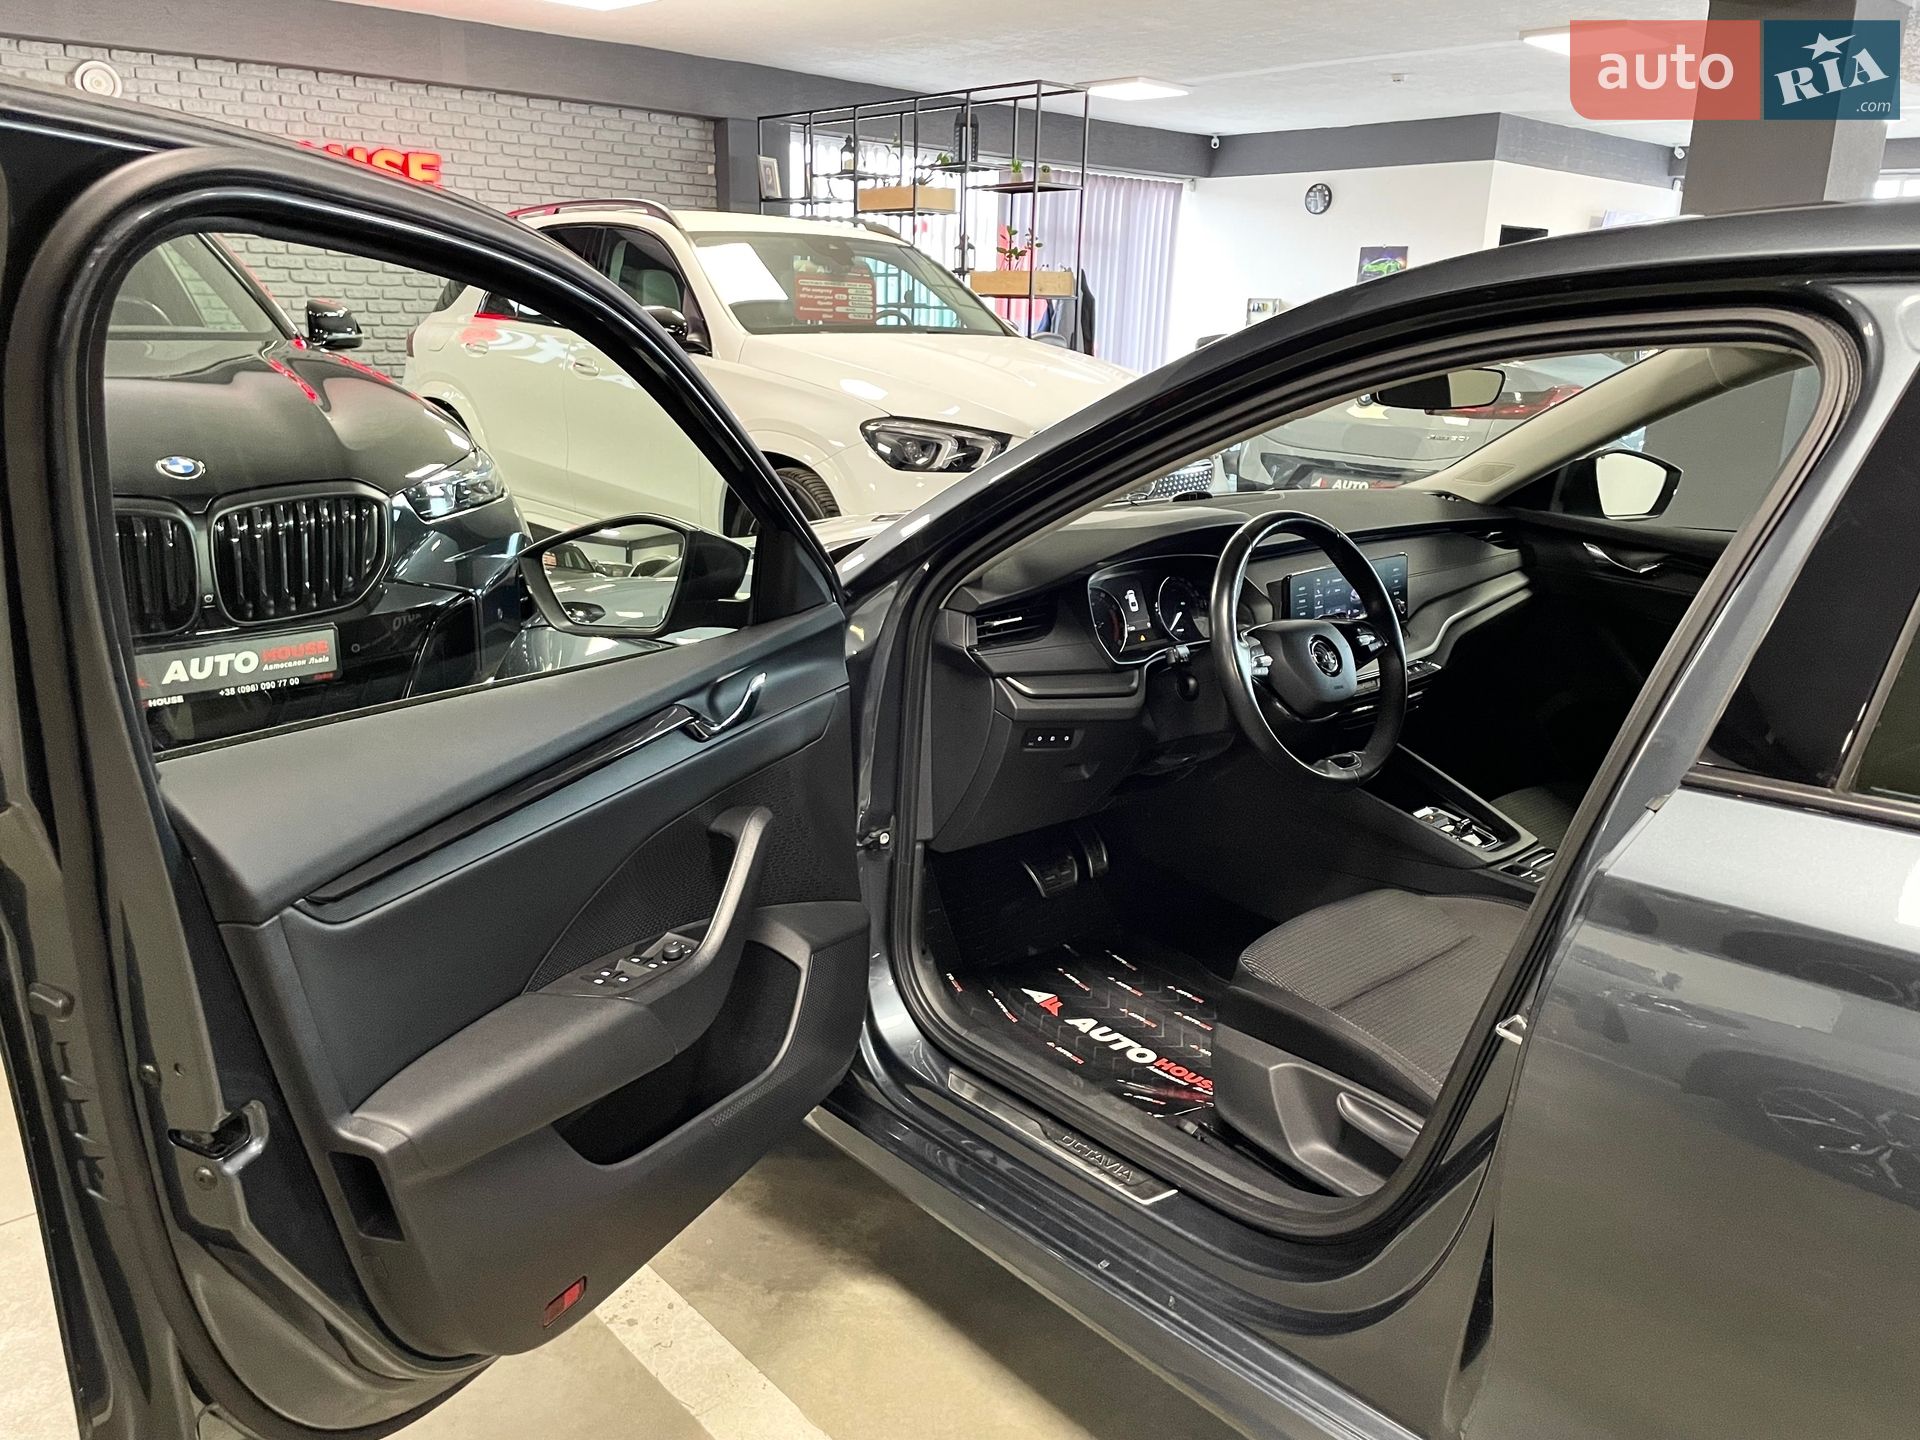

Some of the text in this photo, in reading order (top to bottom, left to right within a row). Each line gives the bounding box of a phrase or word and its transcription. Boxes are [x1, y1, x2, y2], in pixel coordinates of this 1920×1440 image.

[161, 651, 260, 685] AUTO
[1063, 1017, 1158, 1064] AUTO
[1153, 1057, 1213, 1091] HOUS
[1062, 1135, 1134, 1182] OCTAVIA
